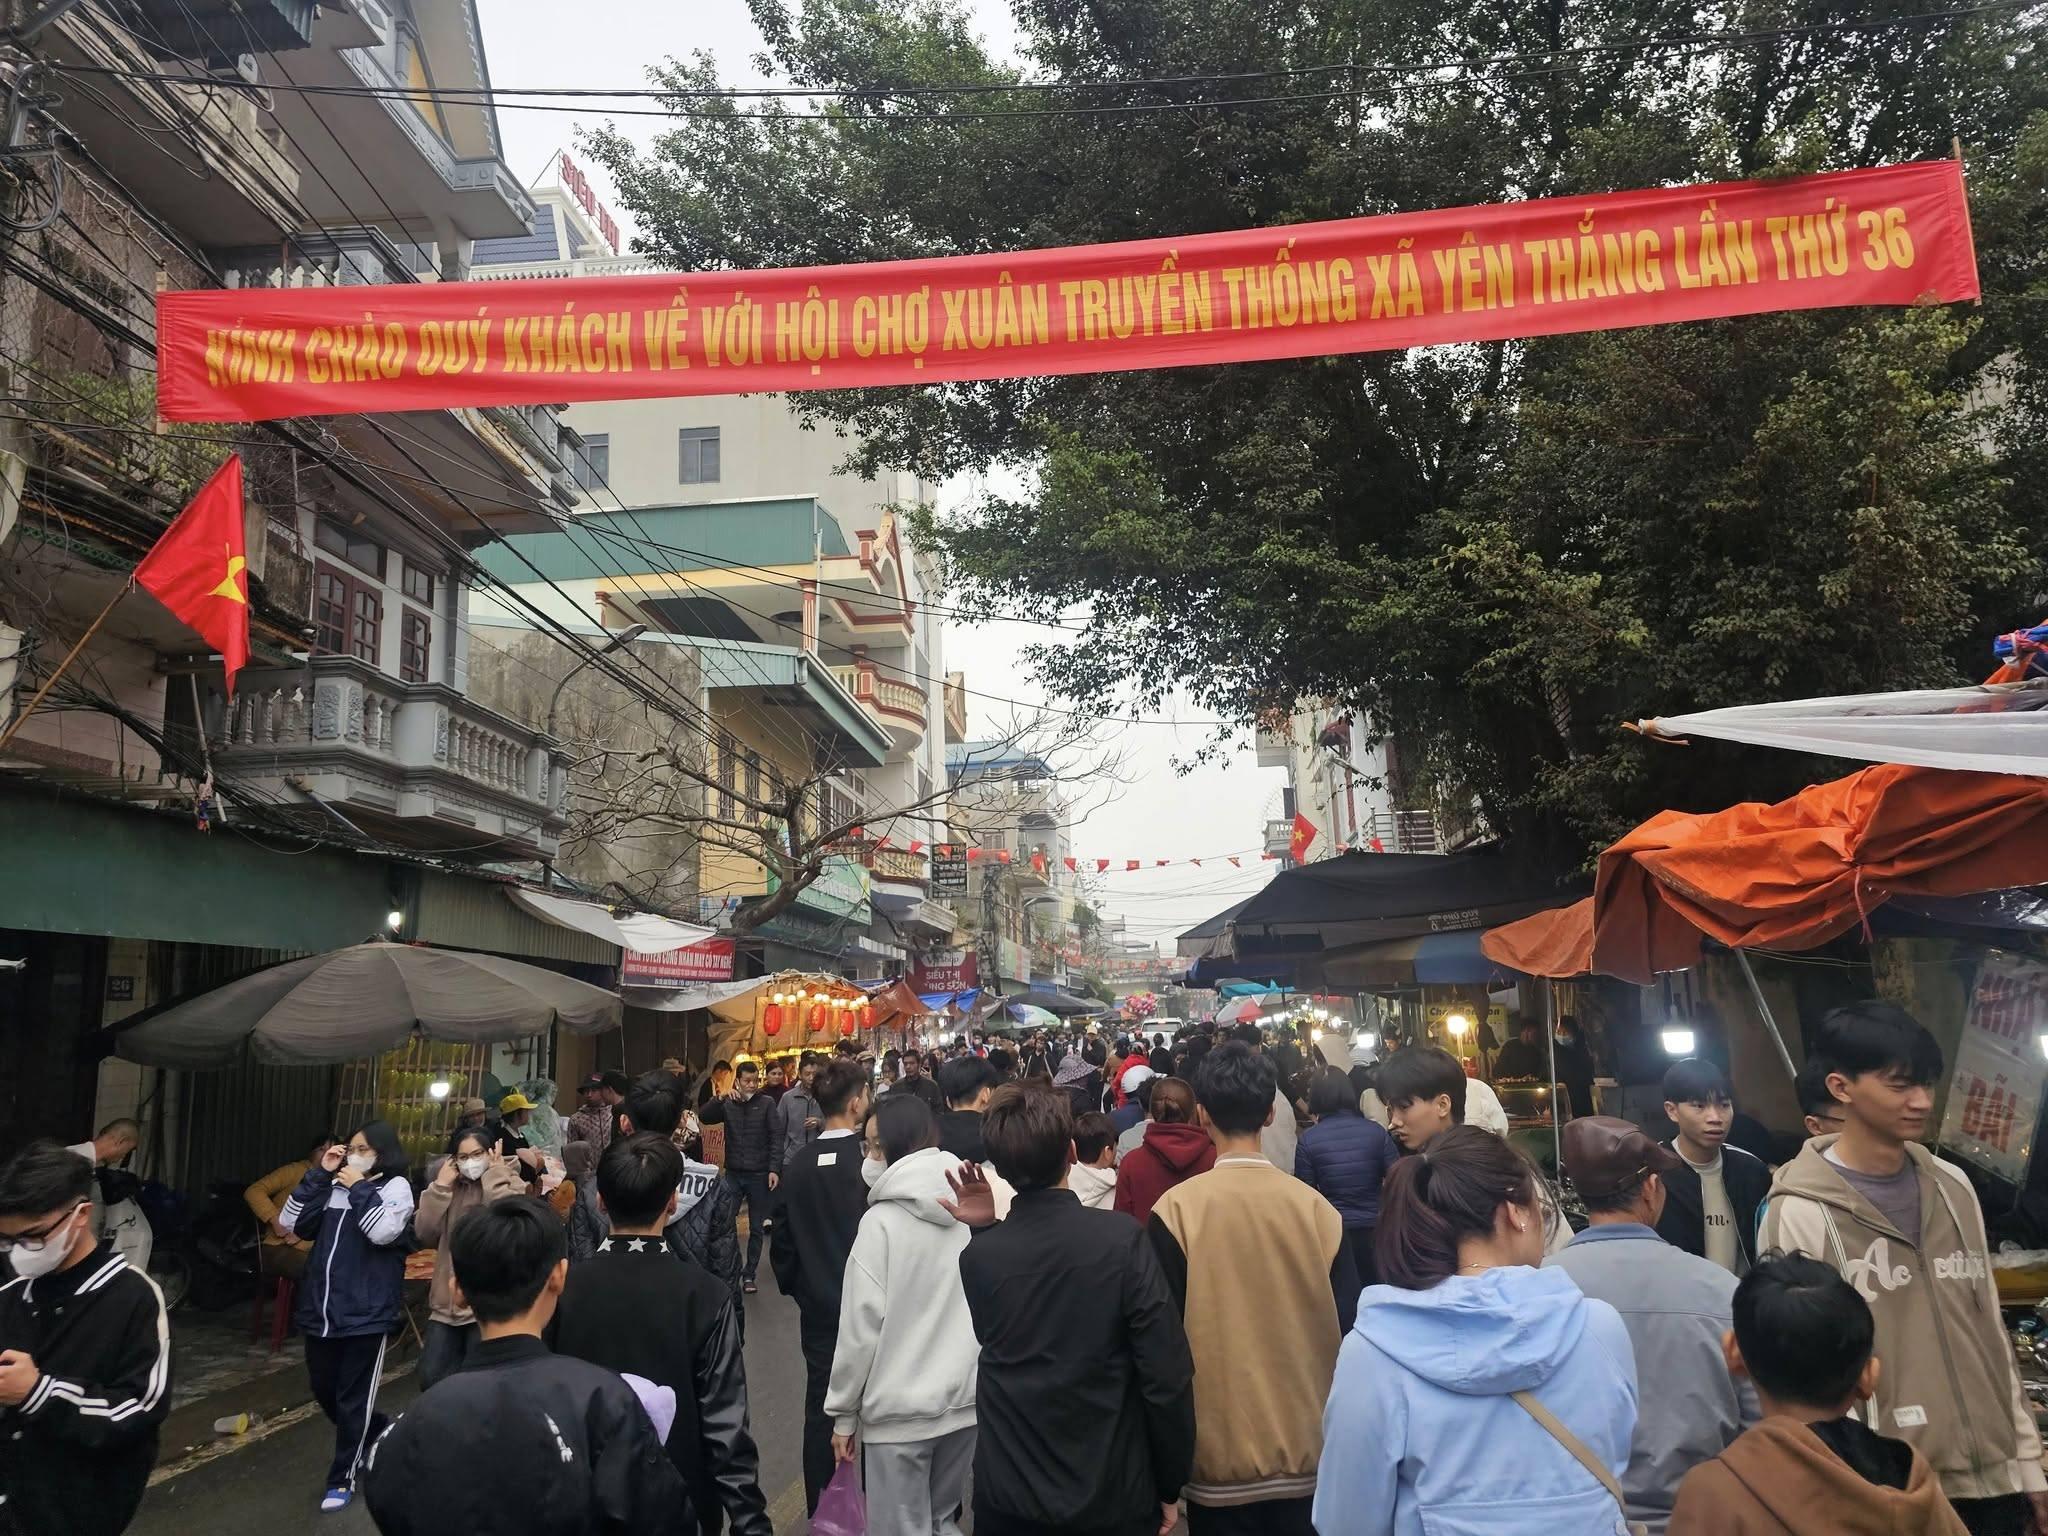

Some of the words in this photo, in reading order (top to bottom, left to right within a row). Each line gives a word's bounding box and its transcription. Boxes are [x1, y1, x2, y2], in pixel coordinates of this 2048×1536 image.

[205, 317, 296, 389] KÍNH
[417, 306, 491, 376] QUÝ
[502, 301, 632, 373] KHÁCH
[644, 286, 690, 370] VỀ
[701, 291, 762, 368] VỚI
[776, 285, 840, 375] HỘI
[853, 285, 930, 369] CHỢ
[942, 271, 1049, 351] XUÂN
[1059, 250, 1213, 342] TRUYỀN
[1222, 238, 1357, 330] THỐNG
[1366, 237, 1425, 320] XÃ
[1431, 231, 1514, 313] YÊN
[1523, 208, 1665, 305] THẮNG
[1673, 199, 1759, 289] LẦN
[1766, 197, 1849, 281] THỨ
[1858, 207, 1915, 271] 36
